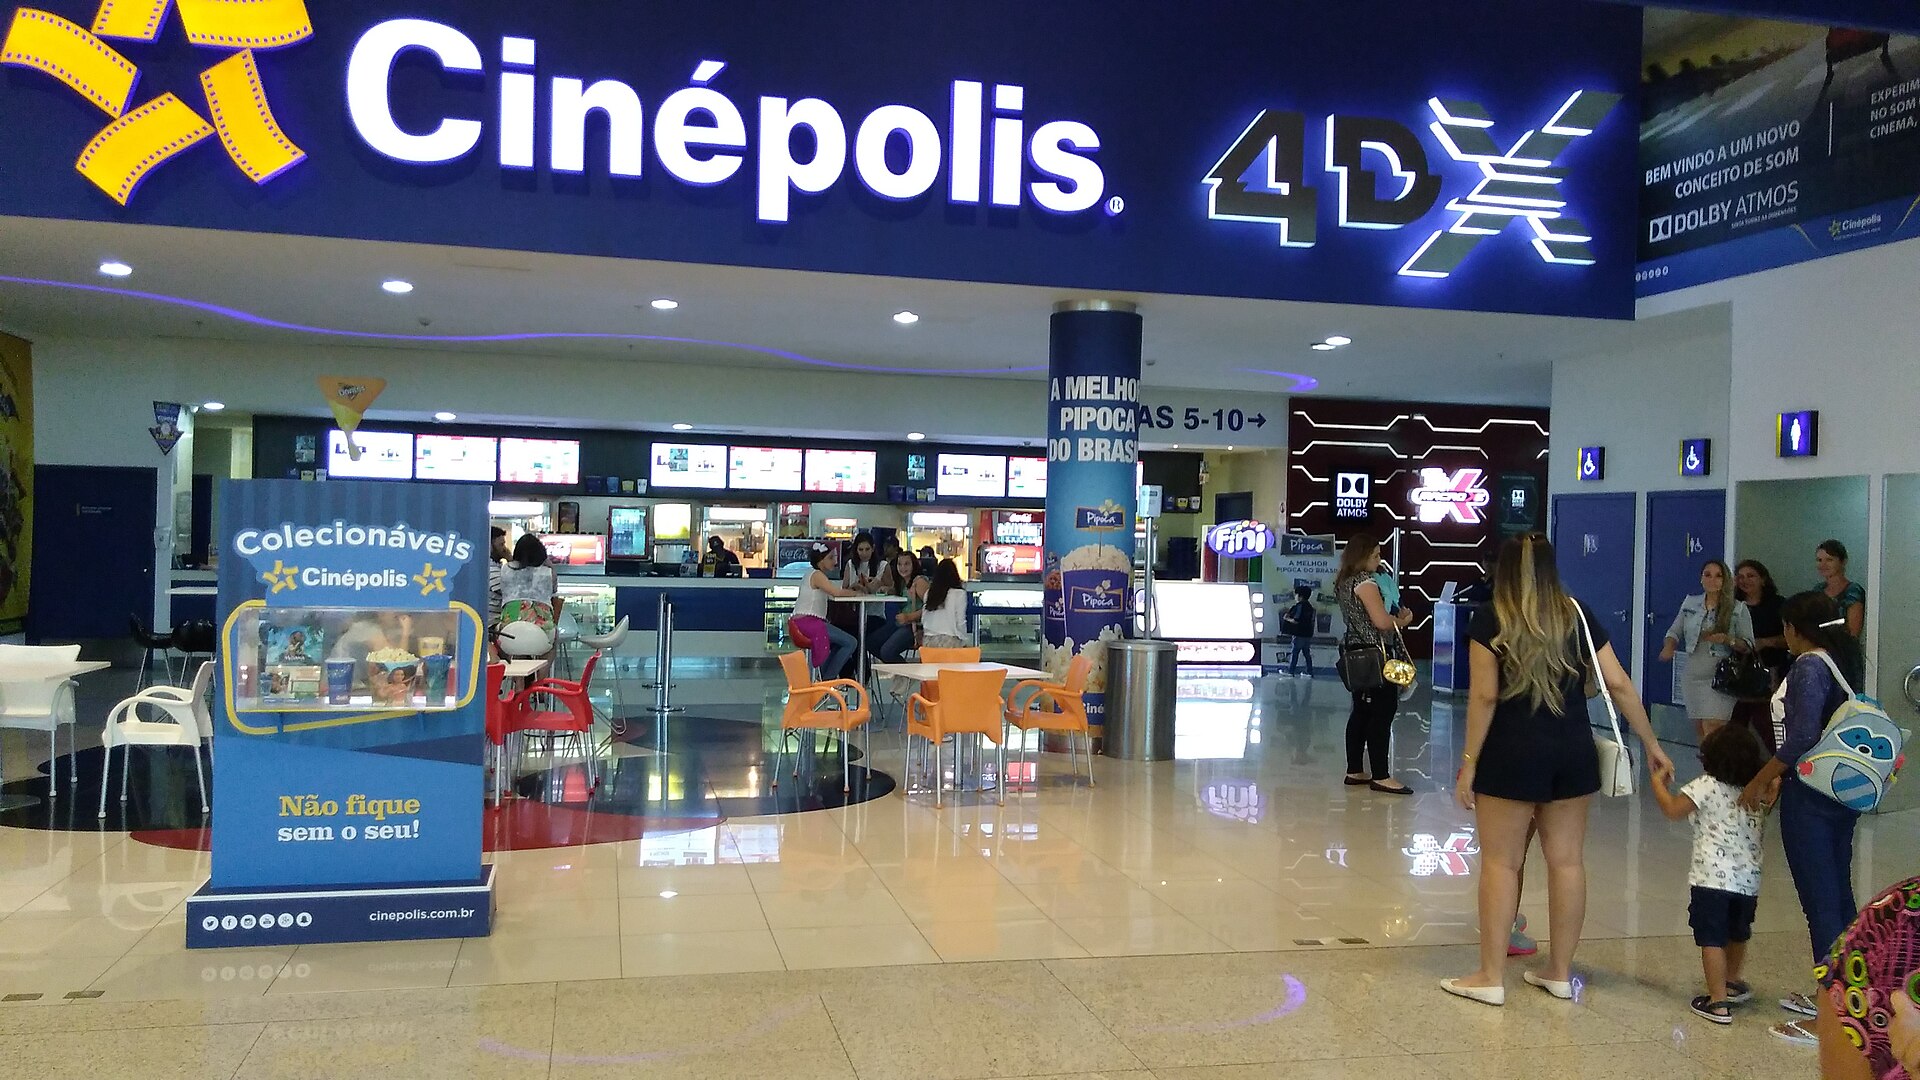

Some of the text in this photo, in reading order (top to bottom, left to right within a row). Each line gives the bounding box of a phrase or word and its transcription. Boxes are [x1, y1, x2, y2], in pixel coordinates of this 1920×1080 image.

[345, 17, 1106, 223] Cinépolis
[1870, 107, 1888, 122] NO
[1890, 97, 1916, 117] SOM
[1869, 115, 1918, 139] CINEMA,
[1645, 119, 1801, 186] BEM VINDO A UM NOVO
[1203, 88, 1622, 279] 4DX
[1675, 146, 1800, 200] CONCEITO DE SOM
[1674, 180, 1800, 234] DOLBY ATMOS
[1050, 377, 1061, 402] A
[1060, 404, 1136, 433] PIPOCA
[1138, 404, 1244, 432] AS 5-10
[1049, 437, 1139, 464] DO BRASI
[1336, 498, 1368, 508] DOLBY
[1336, 508, 1368, 518] ATMOS
[1086, 511, 1116, 526] Pipoca
[236, 521, 472, 560] Colecionáveis
[1215, 522, 1267, 554] Fini
[1290, 538, 1324, 553] Pipoca
[301, 566, 408, 591] Cinépolis
[1081, 592, 1114, 608] Pipoca
[1083, 702, 1105, 714] iné
[278, 793, 421, 820] Não fique
[277, 819, 420, 842] sem o seu!
[369, 907, 475, 923] cinepolis.com.br
